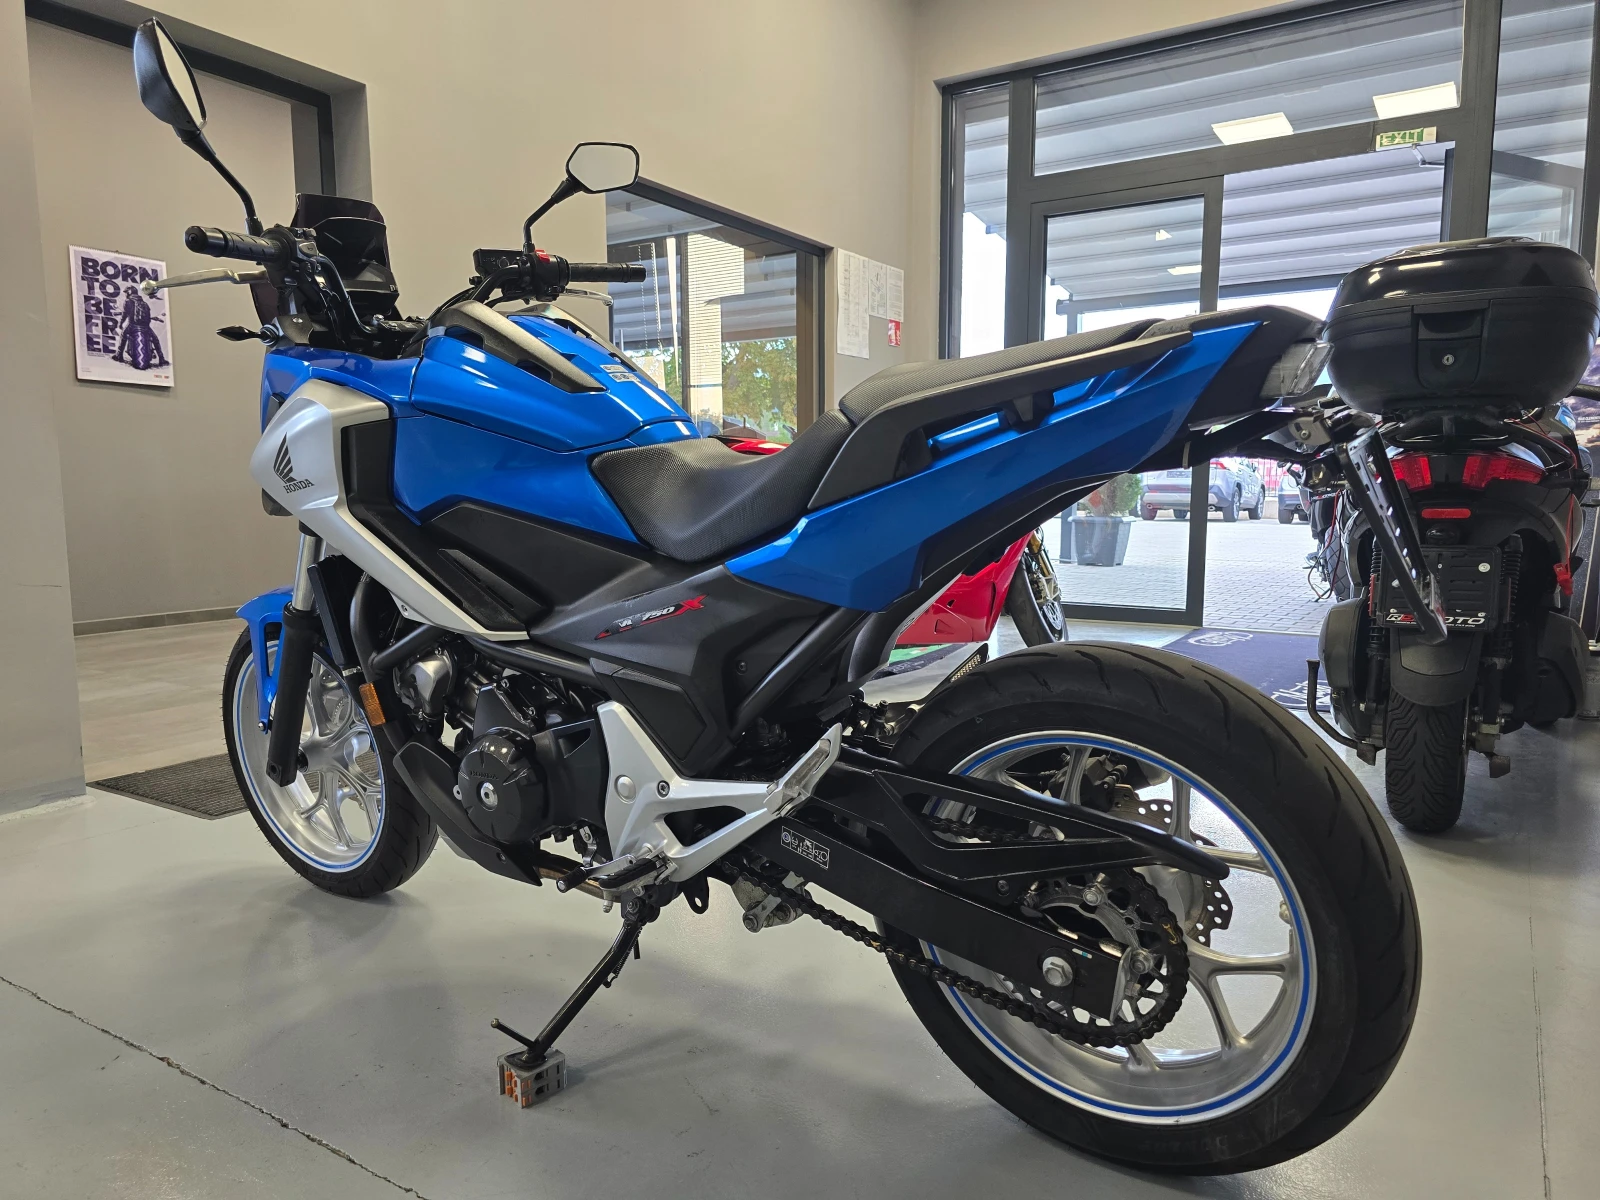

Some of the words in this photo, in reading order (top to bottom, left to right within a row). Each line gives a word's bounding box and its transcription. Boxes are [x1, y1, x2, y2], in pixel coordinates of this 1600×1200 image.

[1381, 130, 1421, 146] EXIT
[81, 256, 159, 284] BORN
[81, 275, 120, 299] TO
[84, 295, 119, 316] BE
[85, 314, 119, 336] FR
[86, 332, 117, 354] EE
[283, 478, 315, 493] HONDA
[470, 770, 499, 780] HONDA
